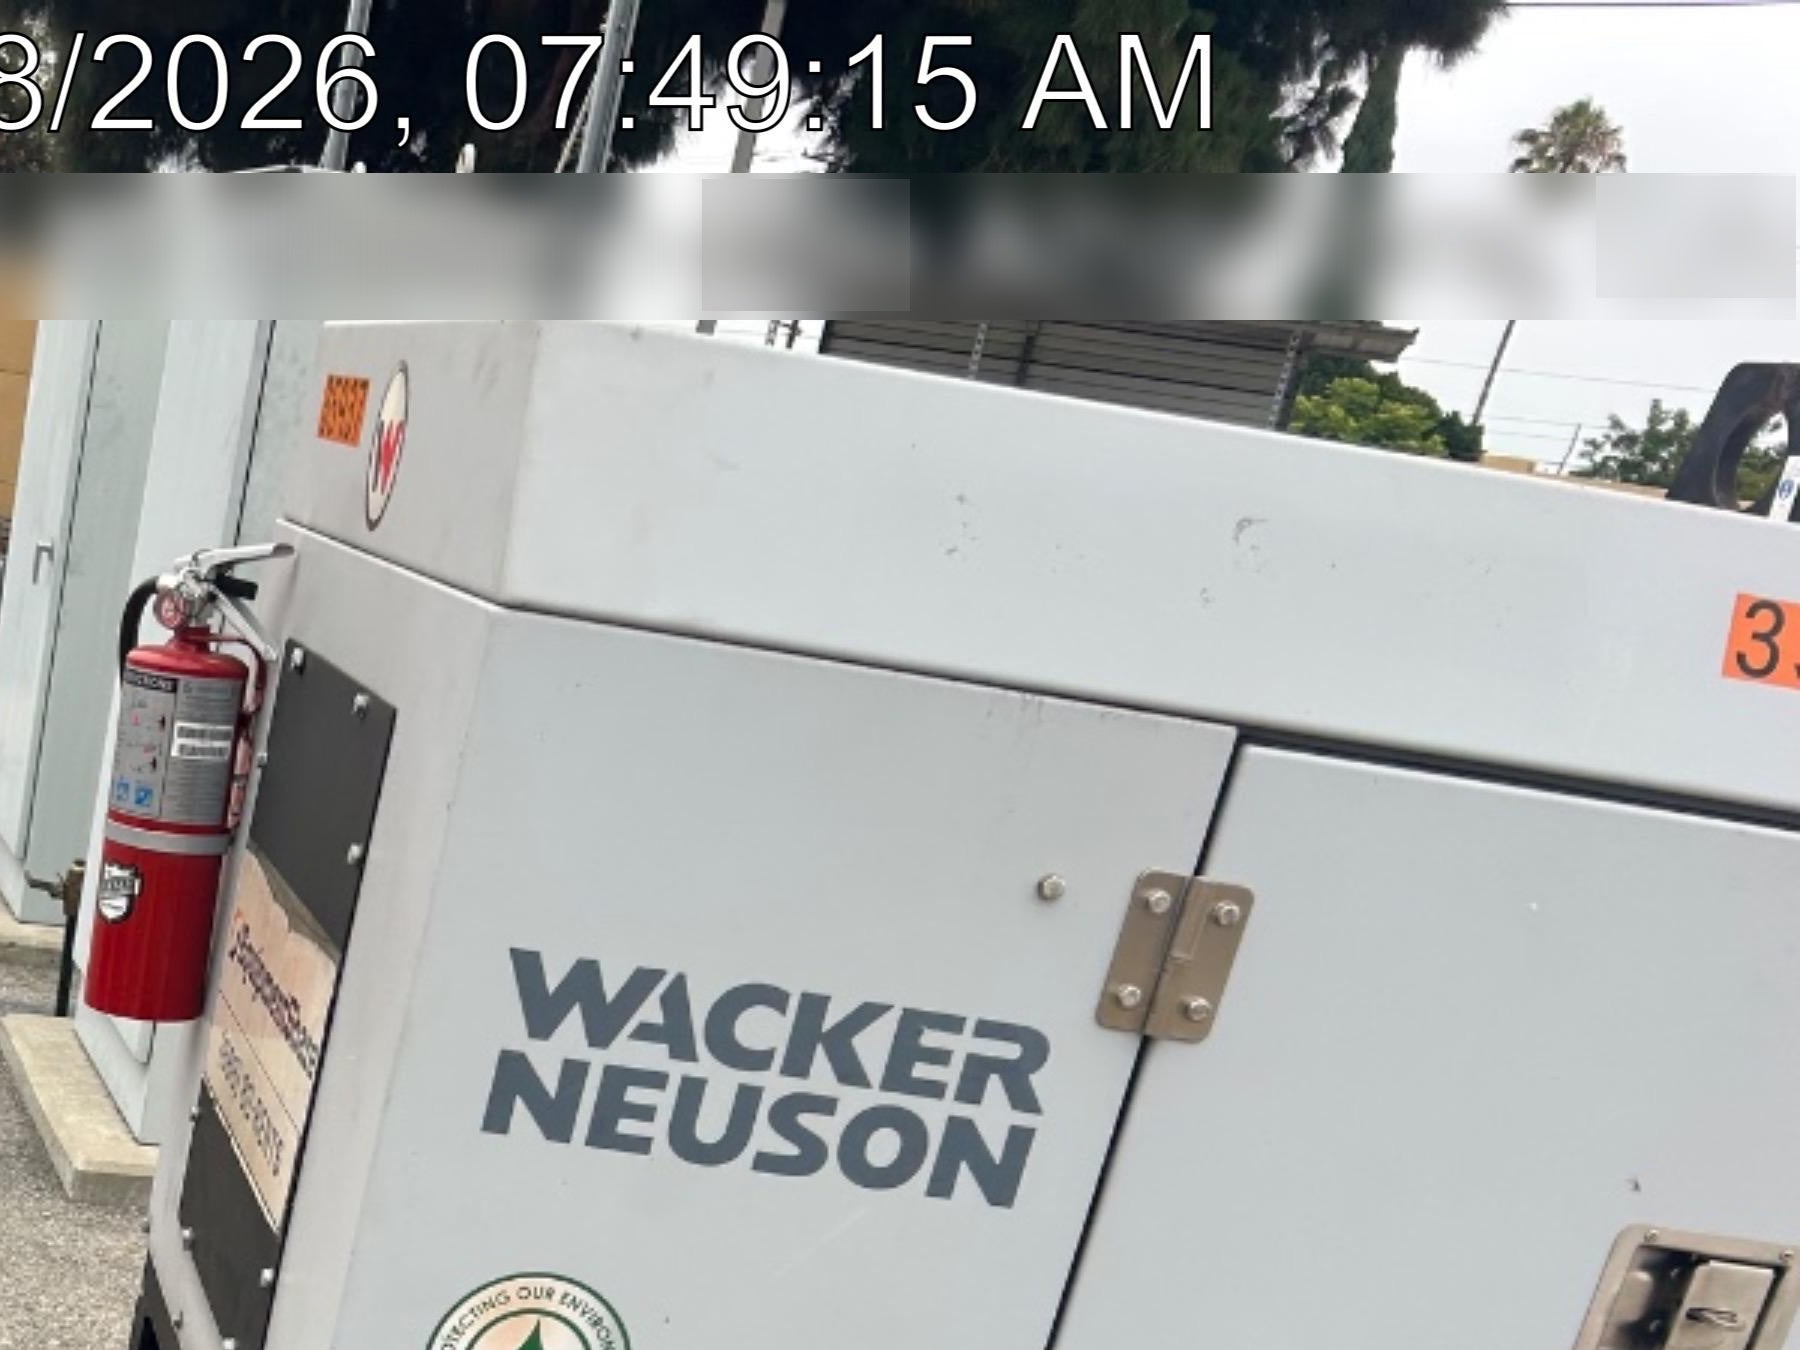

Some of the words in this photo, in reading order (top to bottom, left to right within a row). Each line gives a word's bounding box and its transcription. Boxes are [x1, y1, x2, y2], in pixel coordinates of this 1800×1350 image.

[509, 947, 1051, 1116] WACKER
[480, 1049, 1038, 1209] NEUSON
[515, 1285, 557, 1301] OUR
